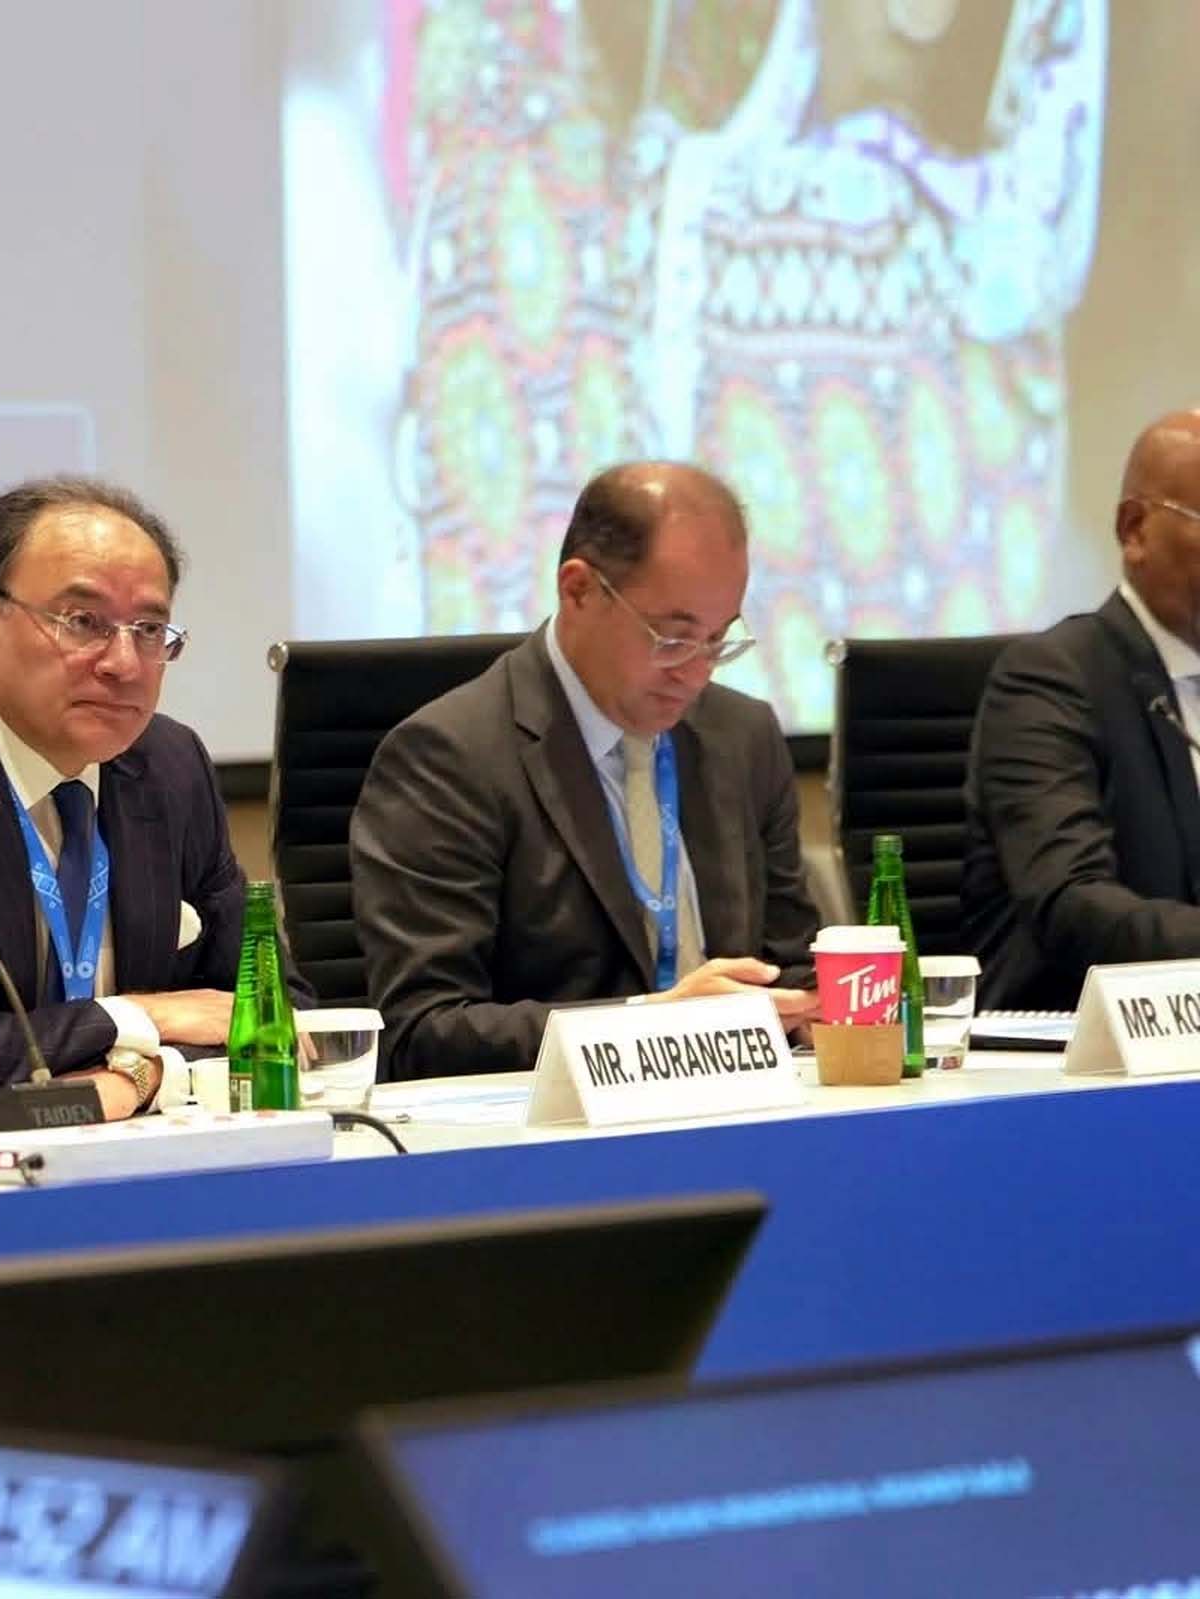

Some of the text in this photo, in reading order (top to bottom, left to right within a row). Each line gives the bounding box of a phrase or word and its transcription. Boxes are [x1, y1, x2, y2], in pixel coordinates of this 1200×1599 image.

[1118, 992, 1200, 1038] MR. KO
[581, 1026, 779, 1087] MR. AURANGZEB
